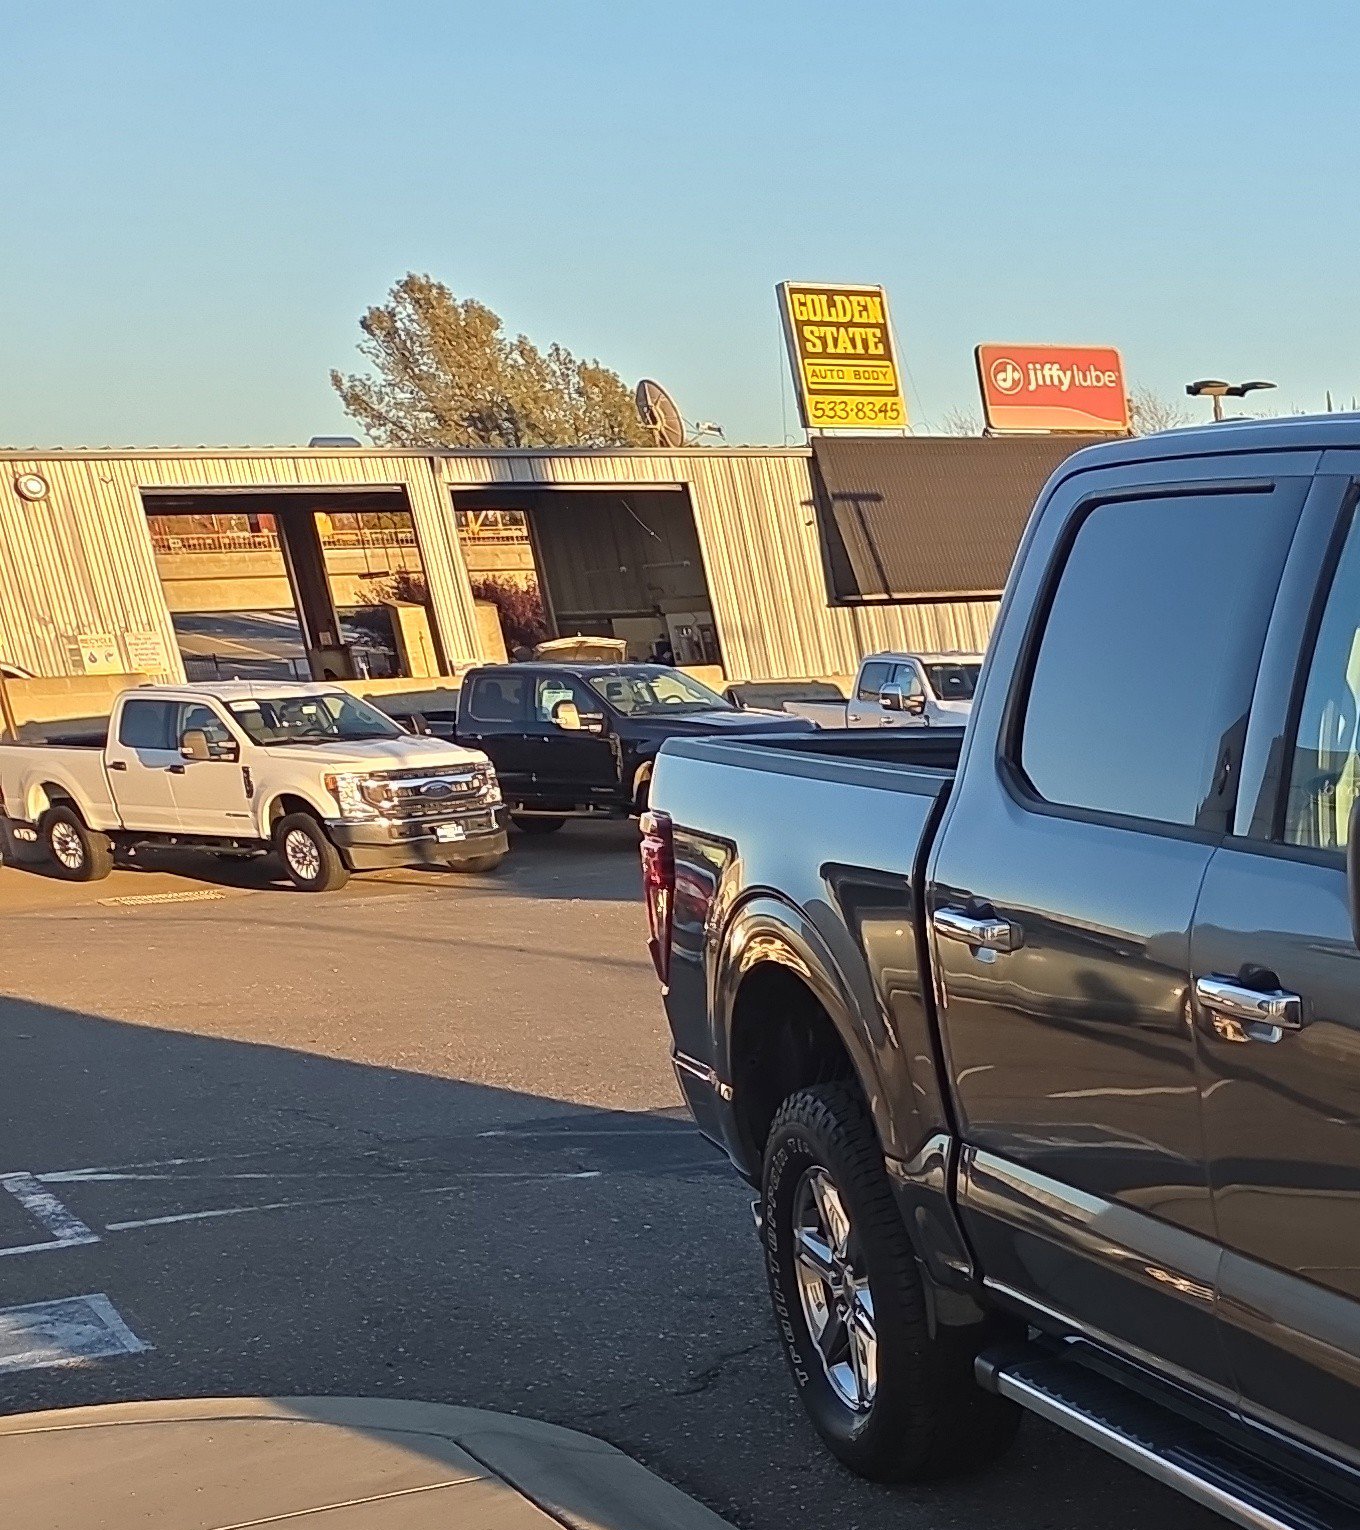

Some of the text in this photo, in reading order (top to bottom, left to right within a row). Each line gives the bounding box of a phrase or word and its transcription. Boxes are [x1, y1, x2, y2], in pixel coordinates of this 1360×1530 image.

[791, 293, 885, 324] GOLDEN
[804, 327, 885, 355] STATE
[810, 368, 888, 381] AUTO BODY
